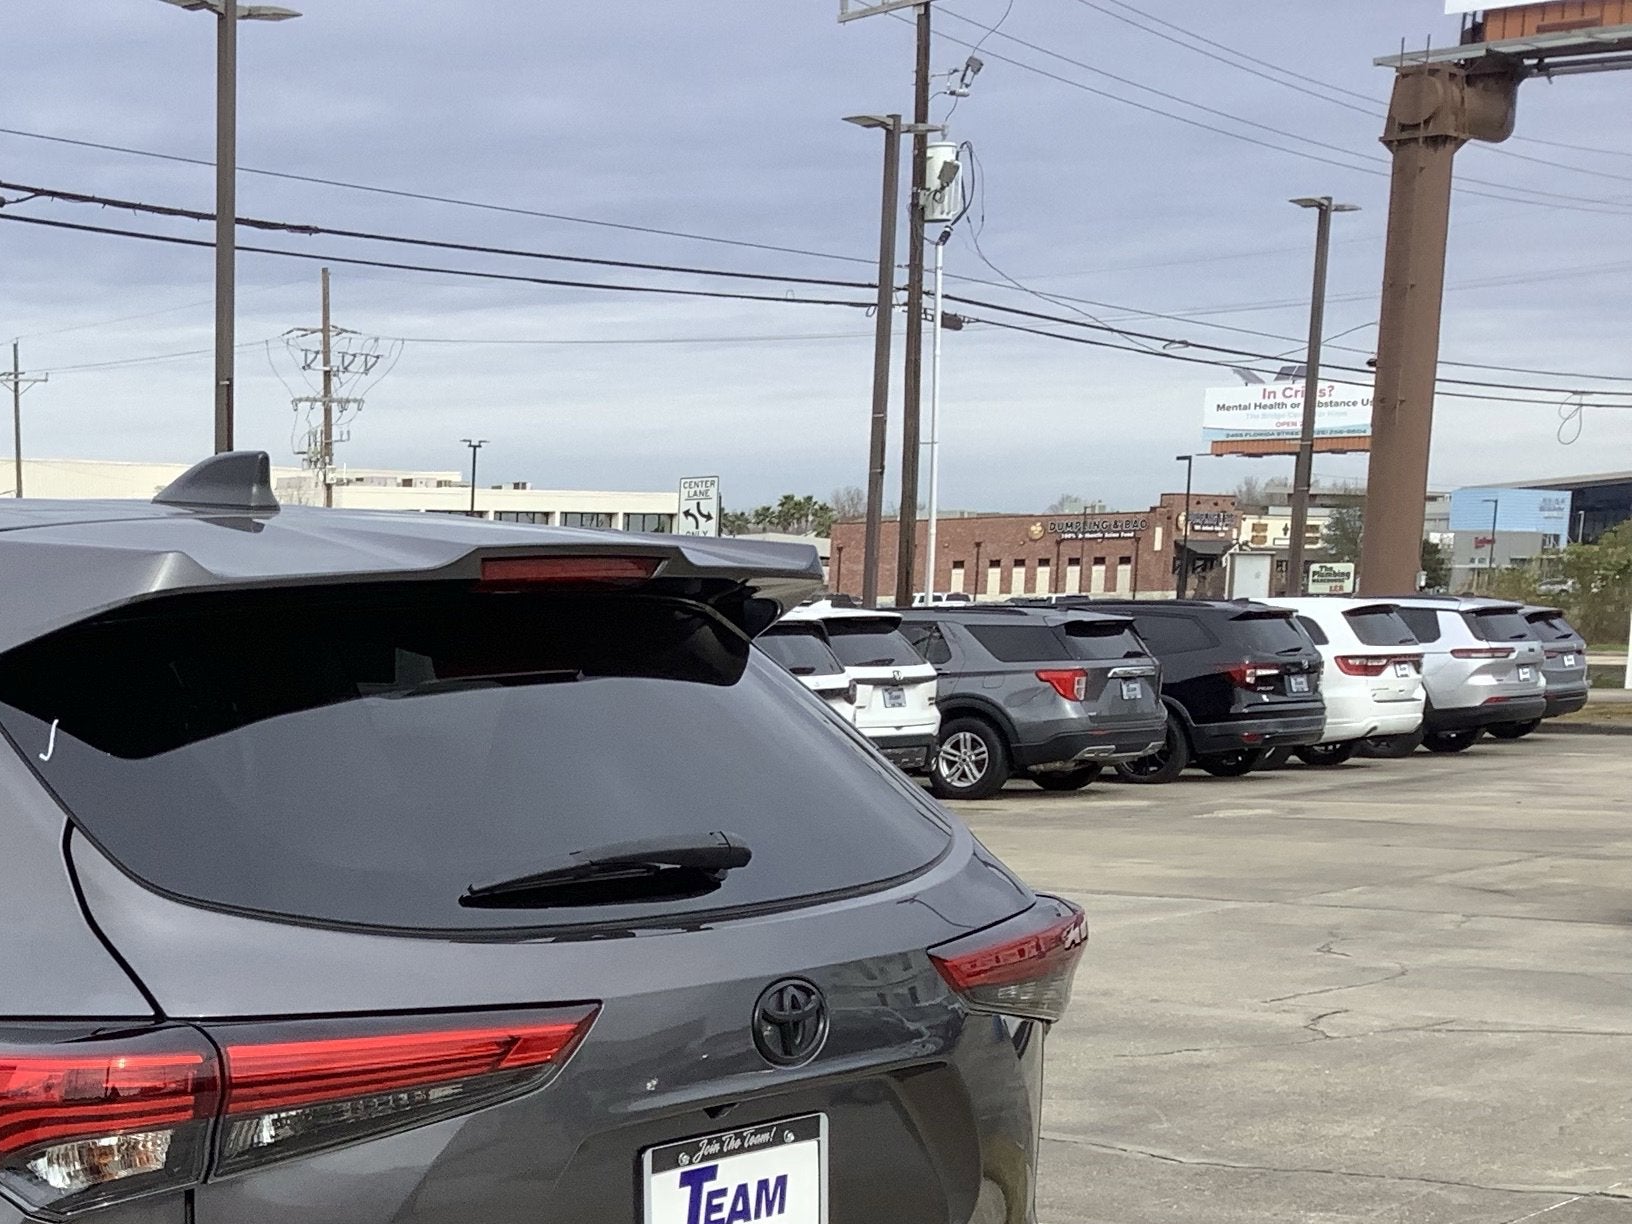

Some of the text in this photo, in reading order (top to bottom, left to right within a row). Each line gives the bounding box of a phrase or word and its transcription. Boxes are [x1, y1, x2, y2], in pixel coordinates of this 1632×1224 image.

[1262, 384, 1335, 400] In Cris?
[1216, 402, 1251, 412] Mental
[1254, 401, 1287, 411] Health
[1317, 399, 1358, 408] bstance
[683, 480, 715, 489] CENTER
[688, 489, 710, 498] LANE
[1124, 519, 1148, 530] BAO
[692, 1126, 777, 1164] Join The Team!
